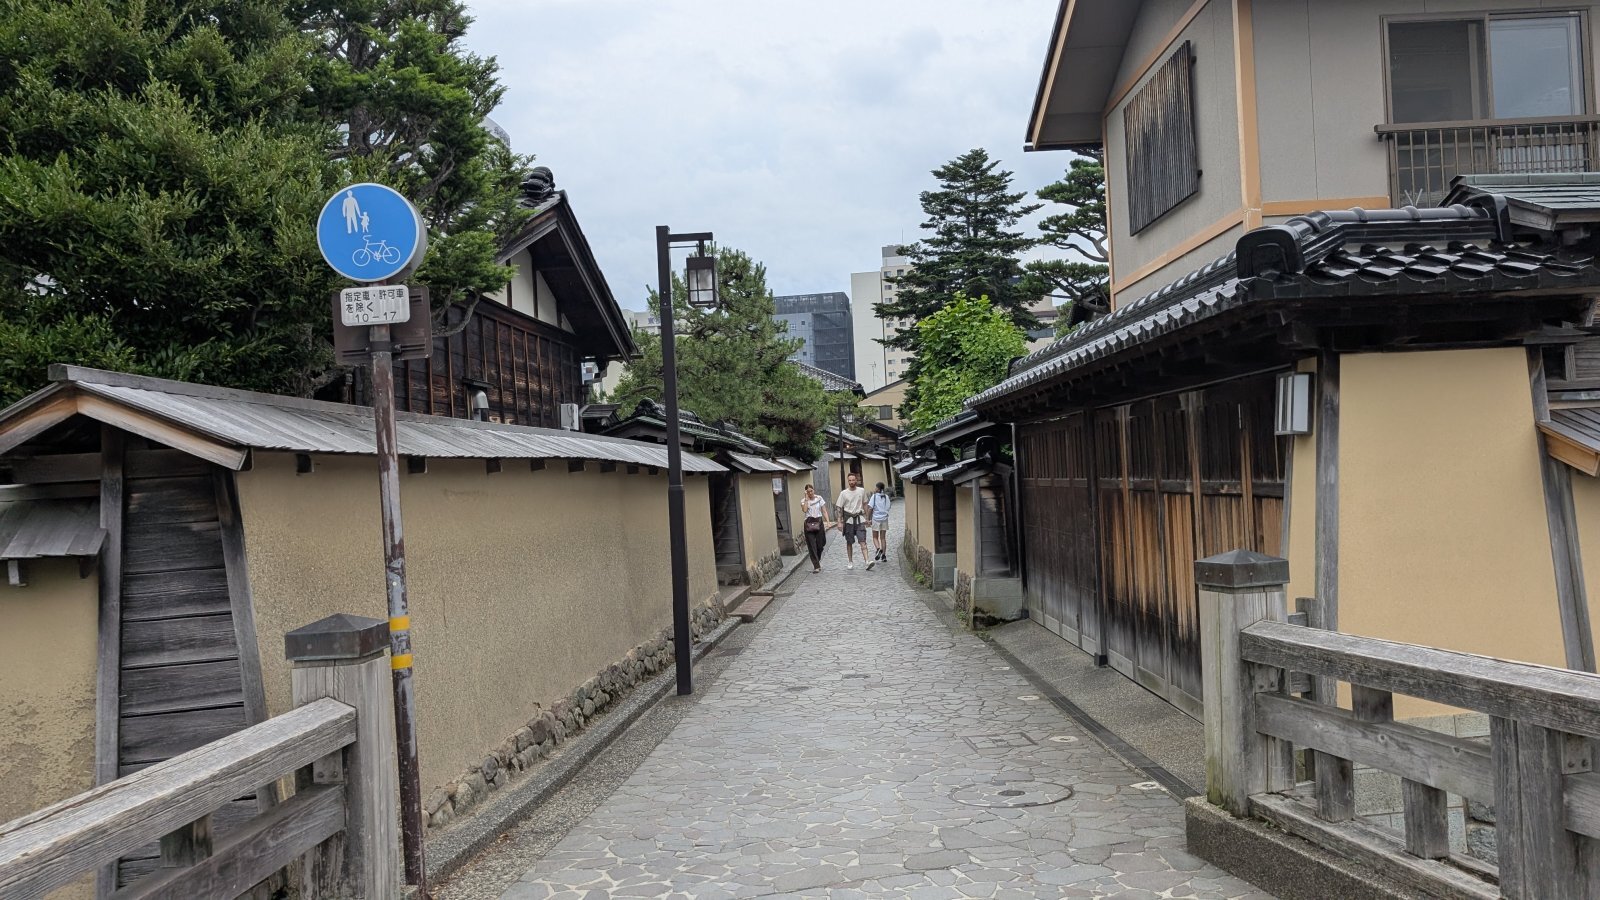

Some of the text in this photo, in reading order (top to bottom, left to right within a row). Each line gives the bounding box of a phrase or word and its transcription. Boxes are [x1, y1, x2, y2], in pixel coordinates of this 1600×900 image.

[345, 288, 404, 302] 指定車・許可車
[346, 302, 373, 313] を除く
[355, 311, 397, 323] 10-17
